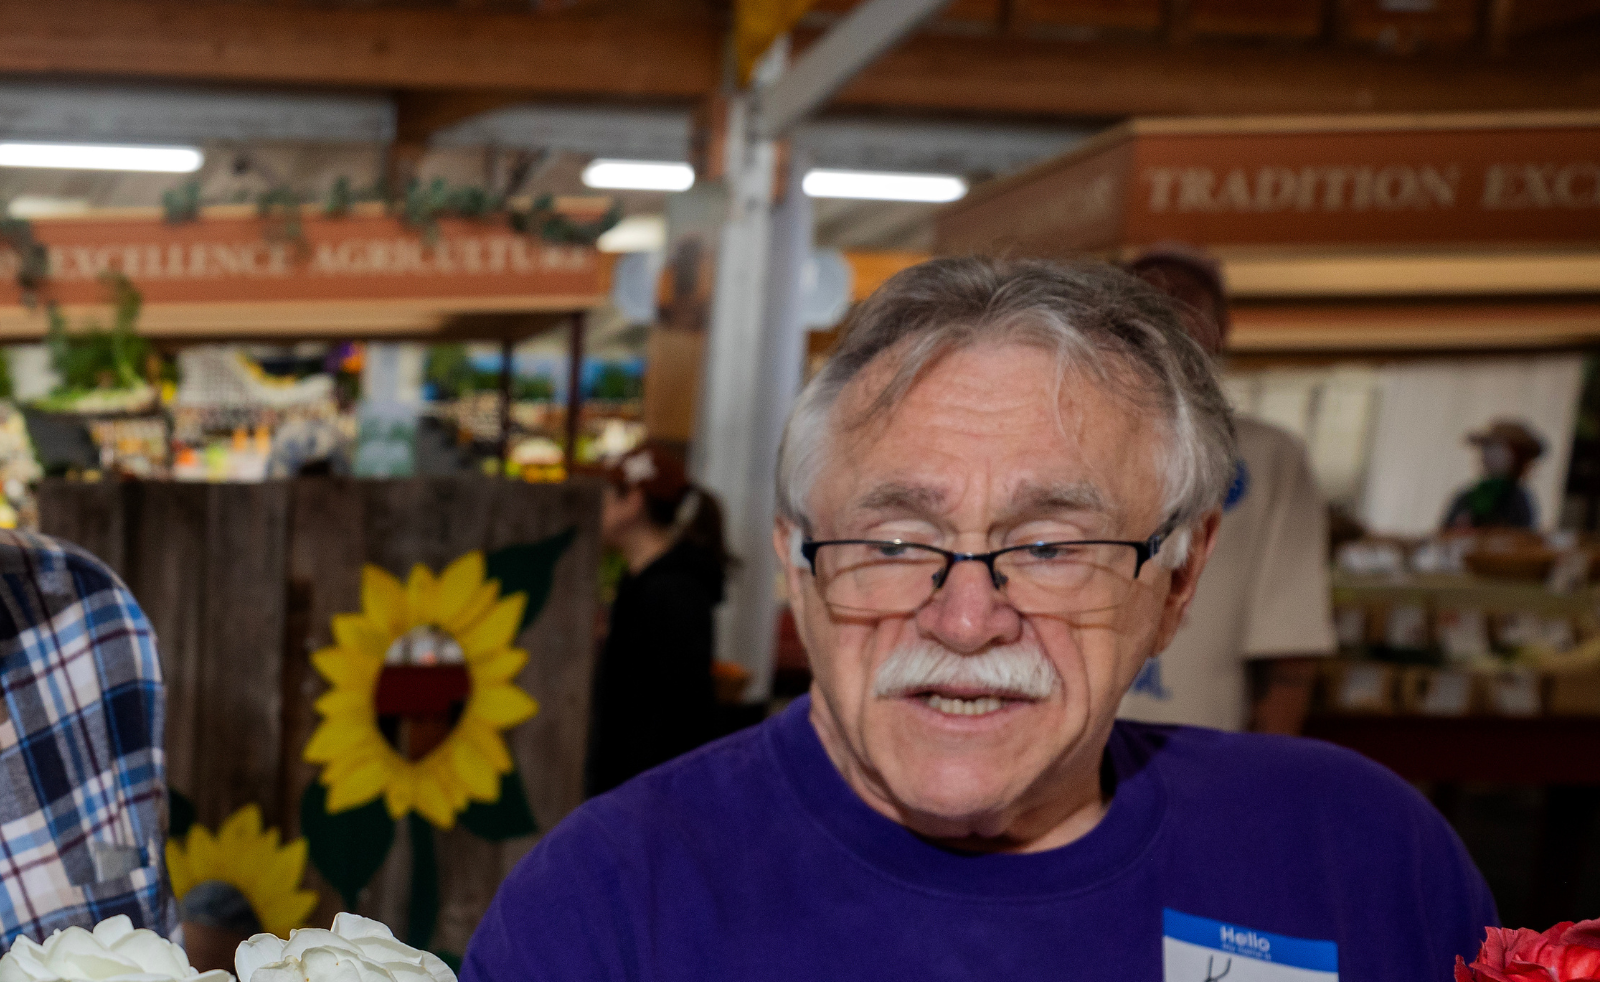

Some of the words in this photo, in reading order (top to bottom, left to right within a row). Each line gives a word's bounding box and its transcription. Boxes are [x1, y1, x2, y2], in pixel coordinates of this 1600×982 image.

[1144, 162, 1460, 213] TRADITION
[45, 242, 289, 281] EXCELLENCE
[1220, 925, 1271, 952] Hello
